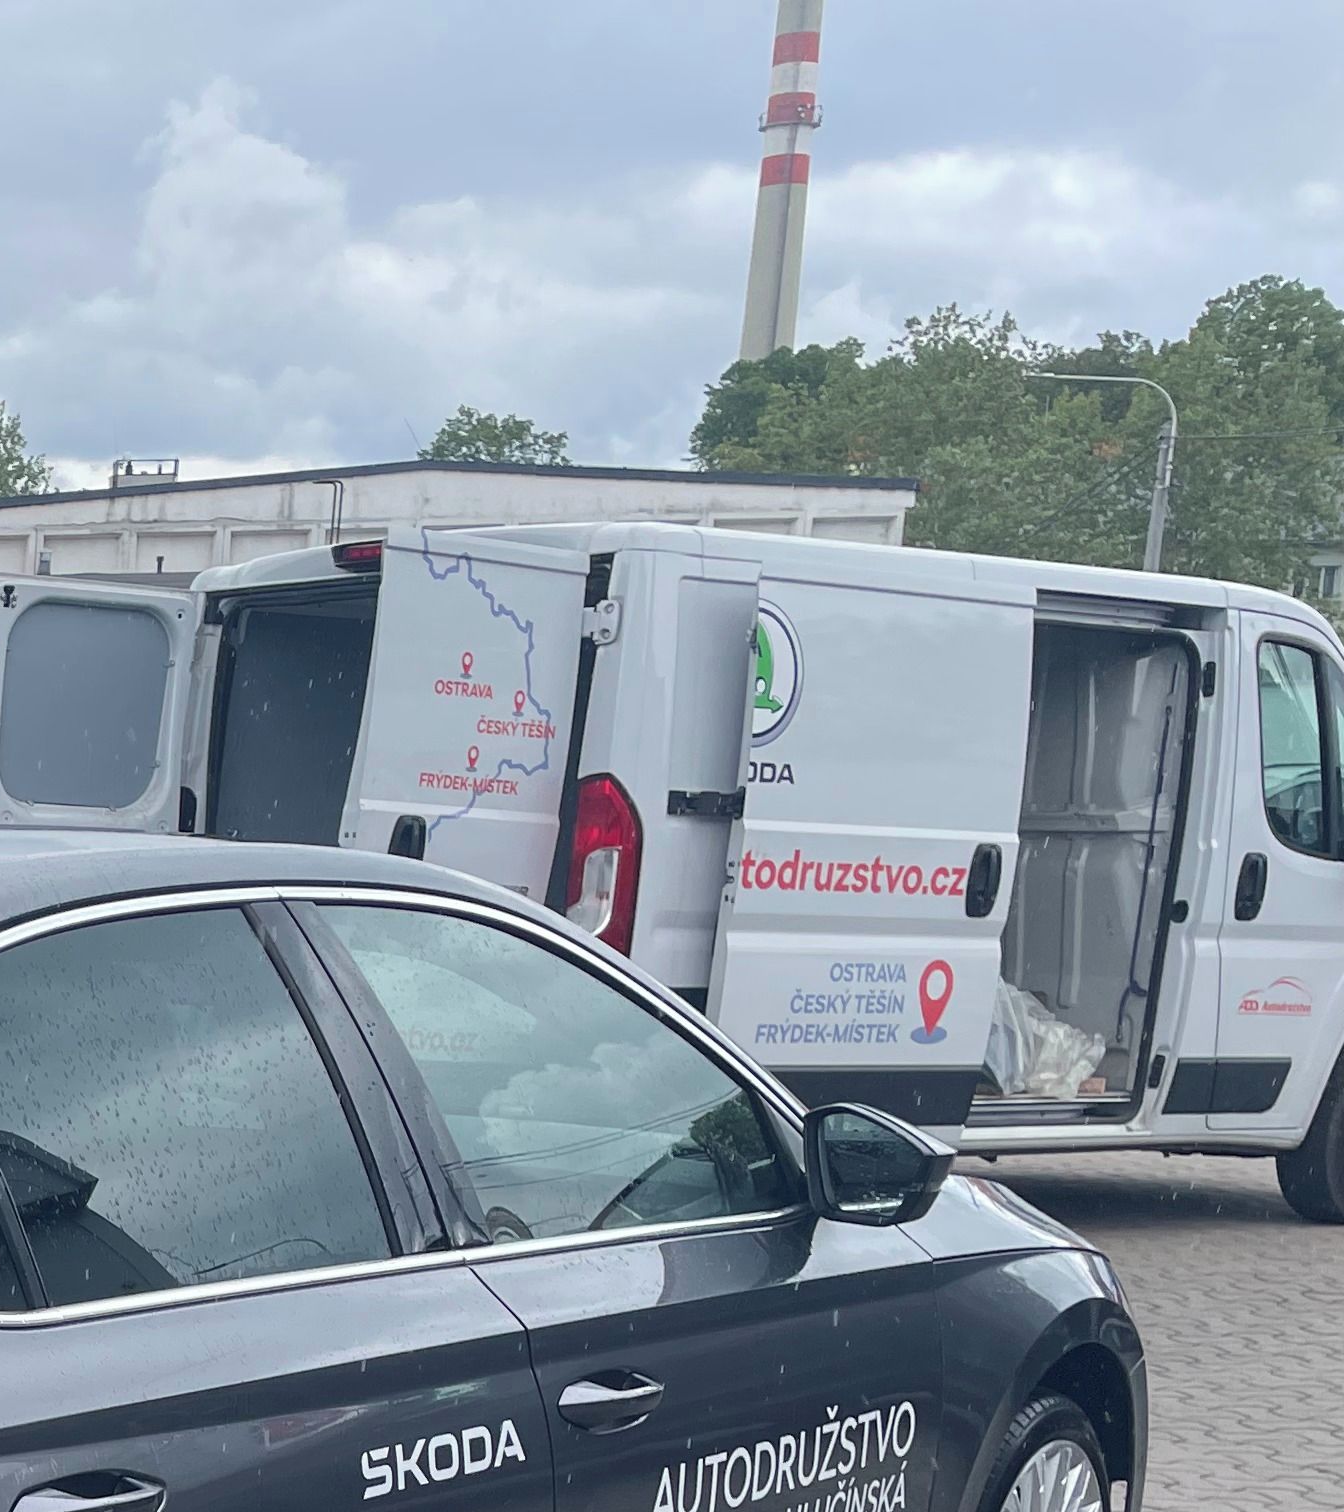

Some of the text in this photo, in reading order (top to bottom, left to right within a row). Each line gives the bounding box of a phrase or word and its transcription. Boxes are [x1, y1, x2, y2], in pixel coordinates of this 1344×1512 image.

[434, 679, 494, 700] OSTRAVA
[476, 715, 520, 737] ČESKÝ
[418, 769, 519, 796] FRÝDEK-MÍSTEK
[747, 761, 795, 785] ODA
[739, 849, 968, 897] todruzstvo.cz
[829, 962, 907, 984] OSTRAVA
[789, 988, 906, 1015] ČESKÝ TĚŠÍN
[754, 1018, 901, 1045] FRÝDEK-MÍSTEK
